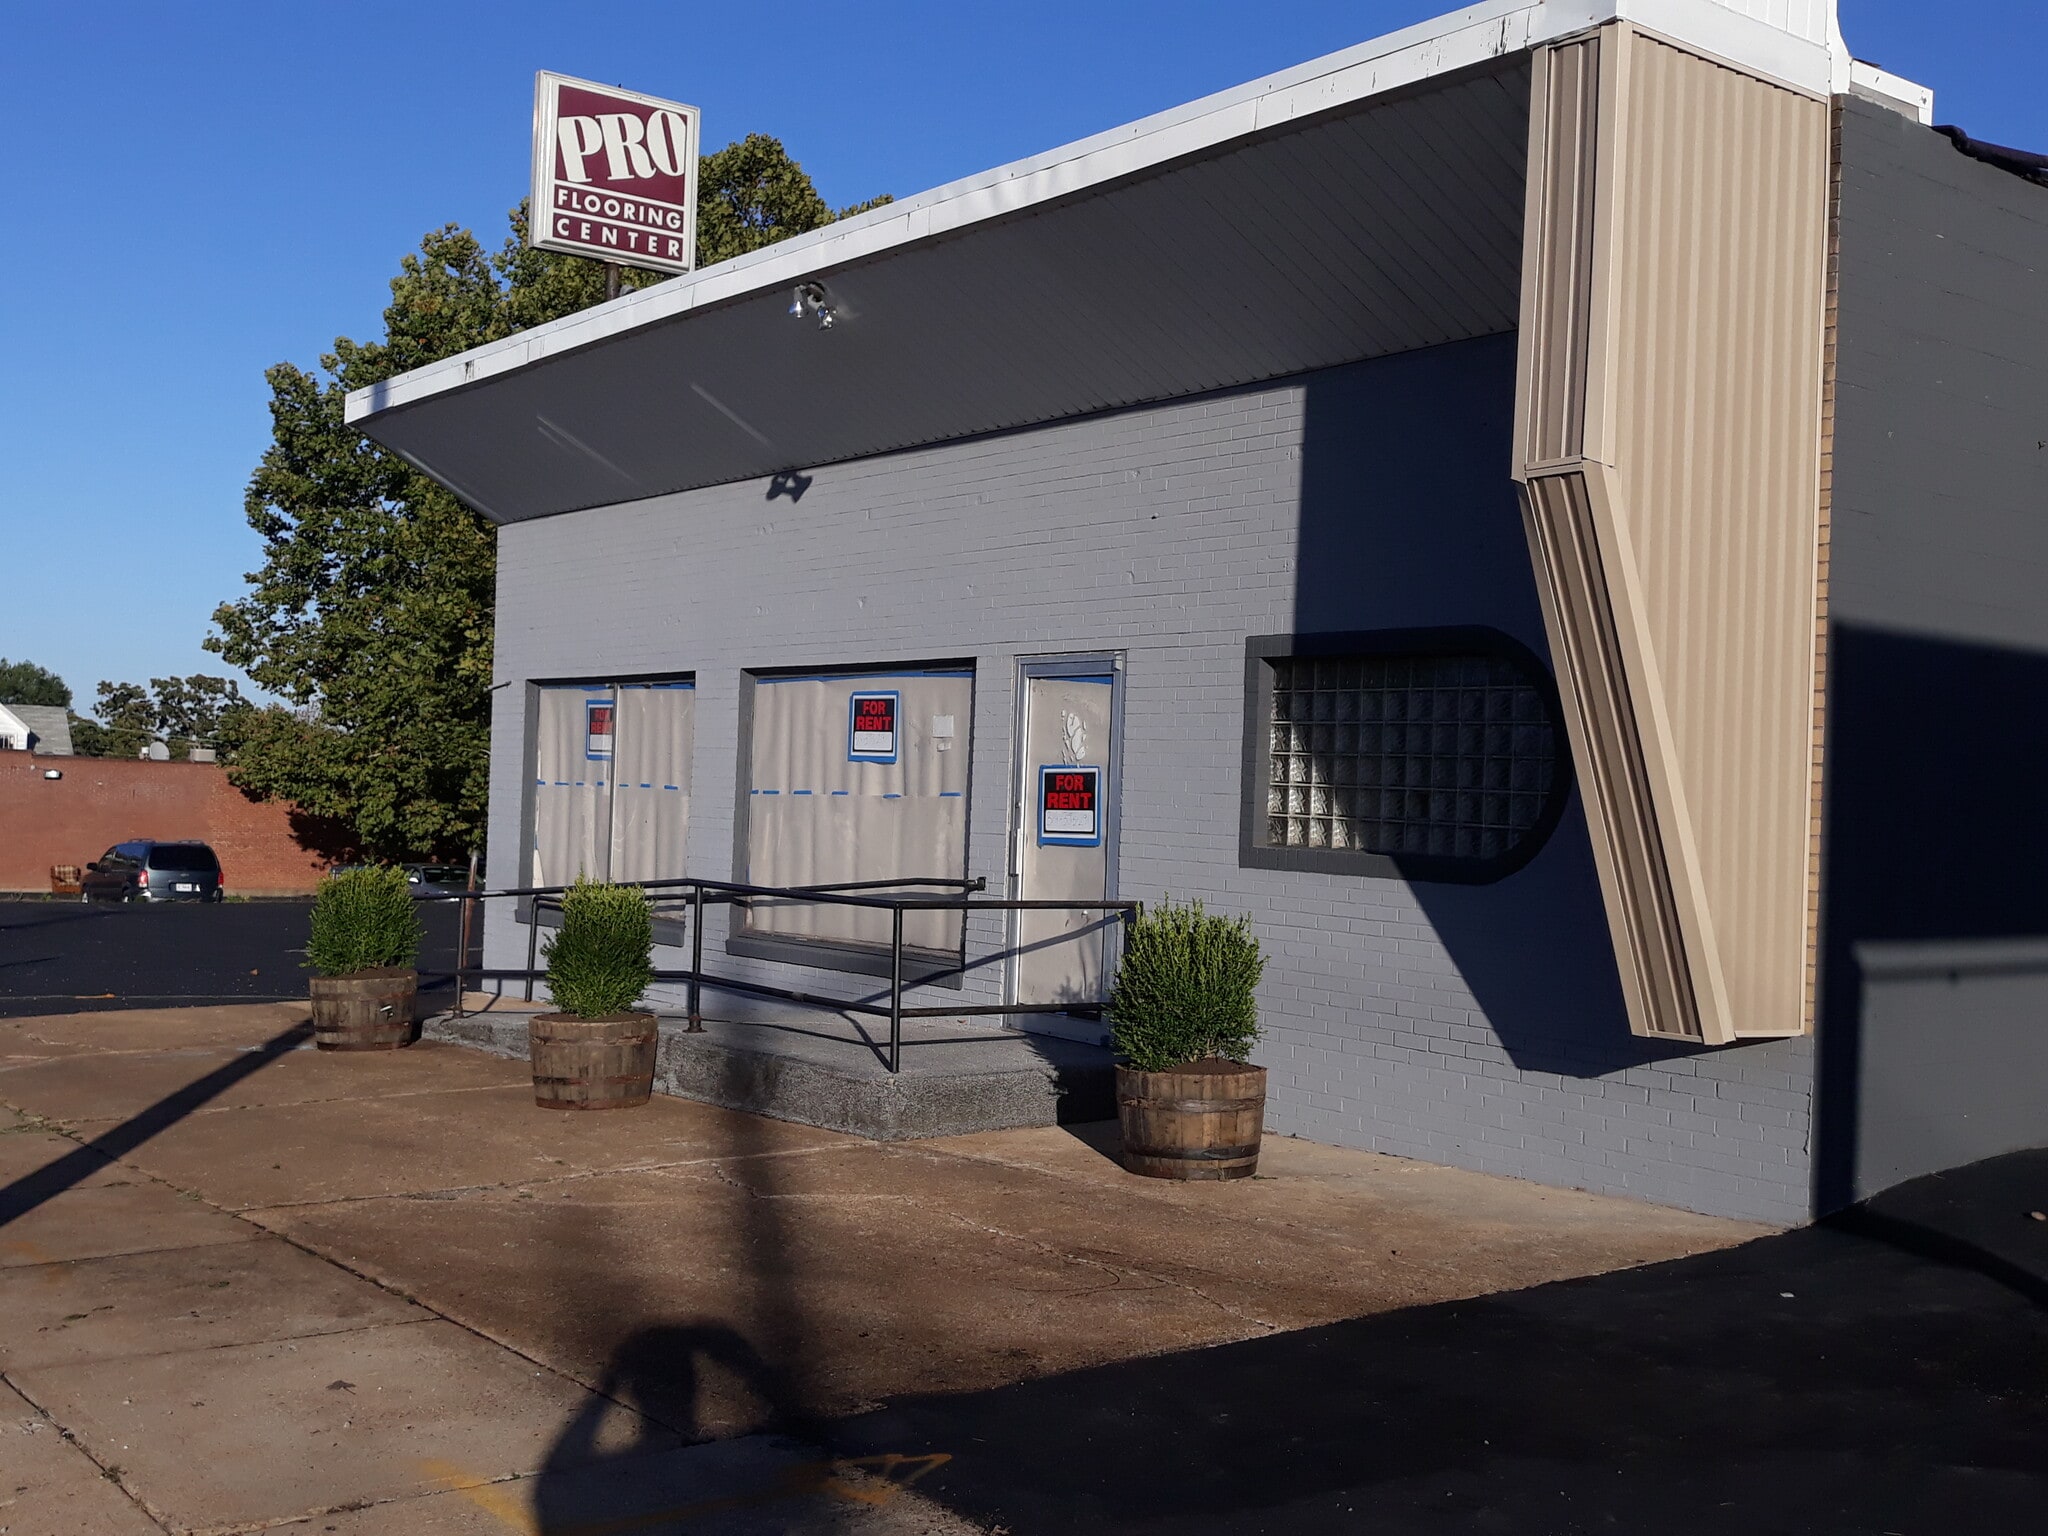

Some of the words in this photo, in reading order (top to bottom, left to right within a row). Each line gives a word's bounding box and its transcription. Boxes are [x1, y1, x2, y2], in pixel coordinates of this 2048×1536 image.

[557, 109, 687, 183] PRO
[557, 189, 682, 229] FLOORING
[556, 217, 681, 257] CENTER
[862, 701, 886, 715] FOR
[856, 716, 892, 730] RENT
[1055, 774, 1085, 791] FOR
[1047, 792, 1093, 809] RENT
